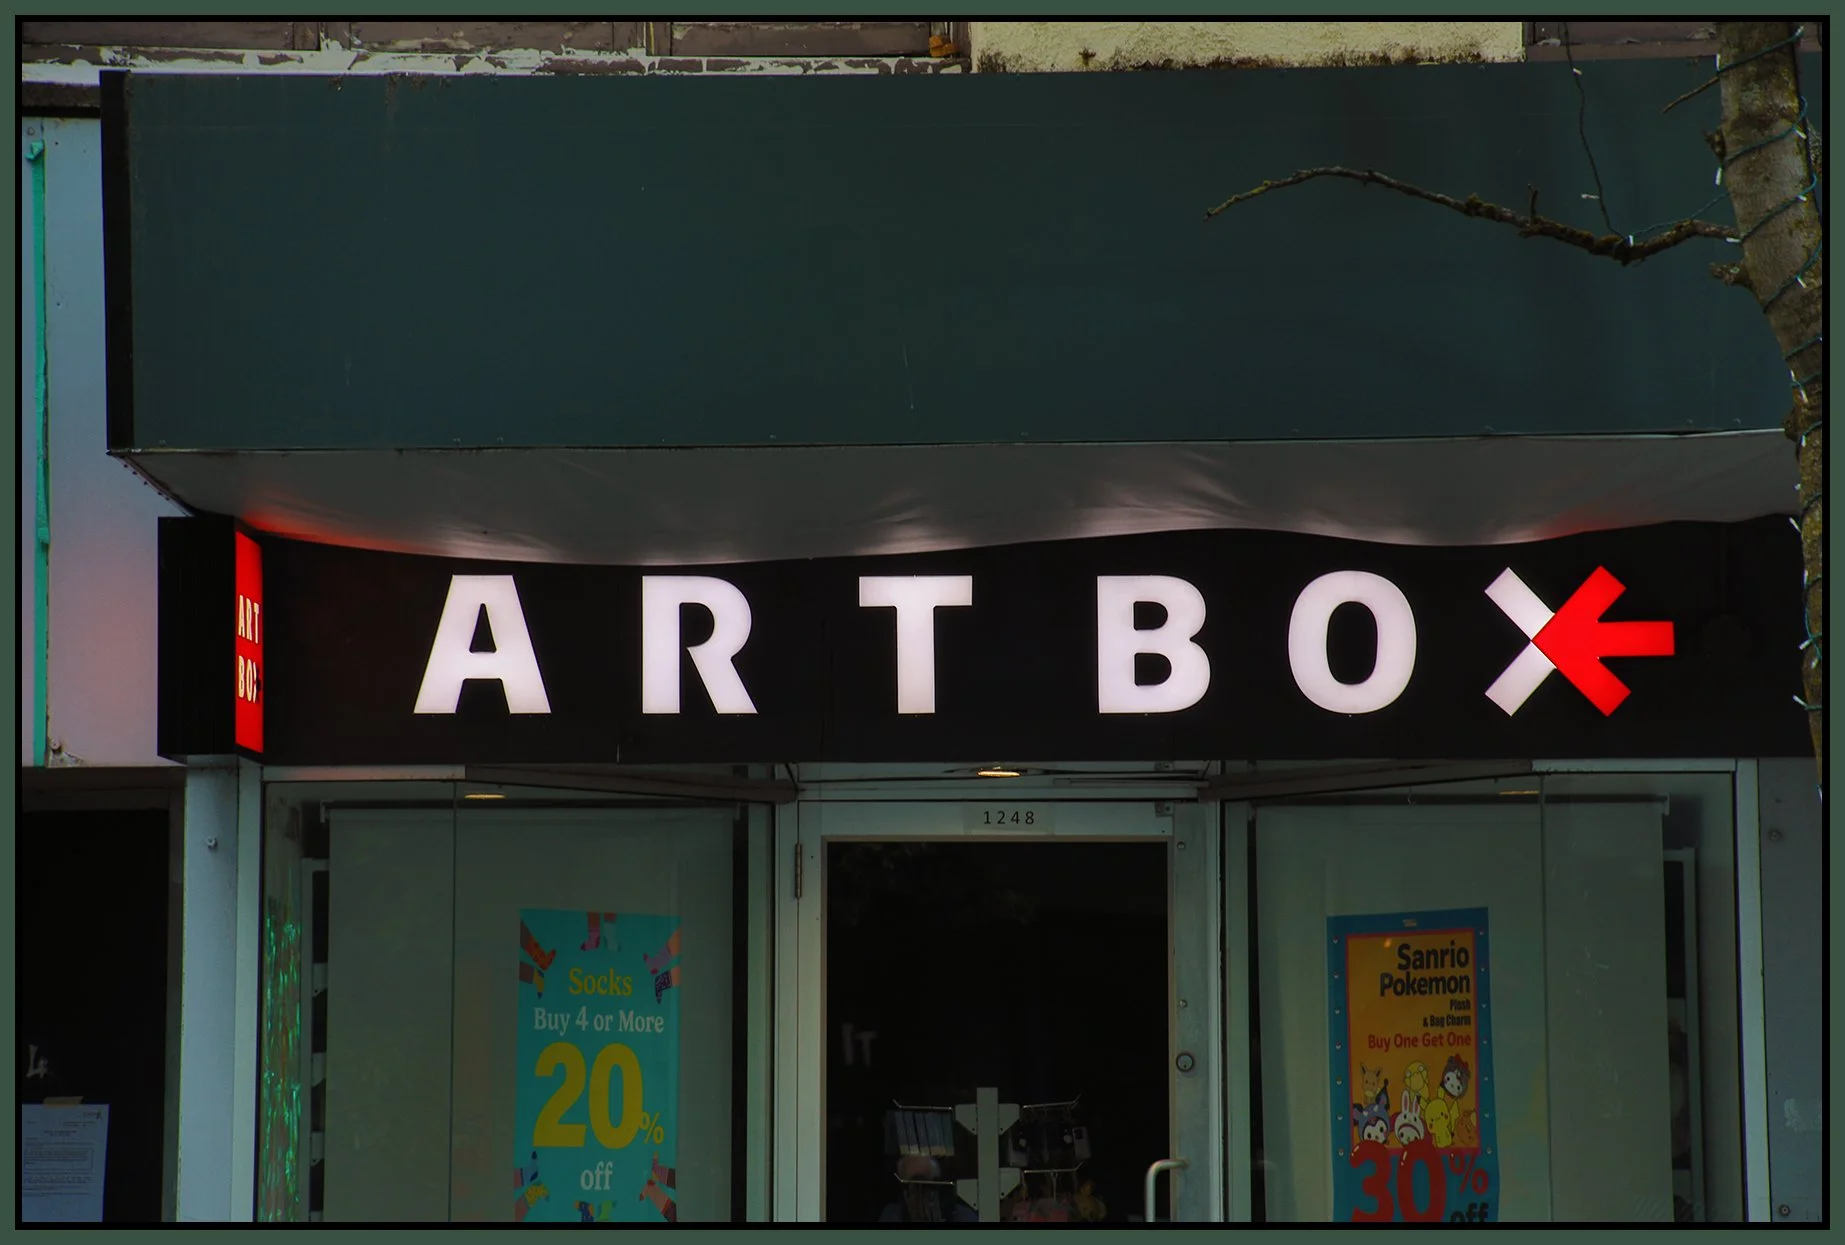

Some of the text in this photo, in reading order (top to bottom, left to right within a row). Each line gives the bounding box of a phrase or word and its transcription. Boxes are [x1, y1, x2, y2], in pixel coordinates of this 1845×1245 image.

[237, 594, 260, 644] ART
[983, 811, 1035, 825] 1248
[1397, 940, 1469, 970] Sanrio
[568, 967, 633, 997] Socks
[1380, 972, 1470, 997] Pokemon
[1450, 999, 1471, 1010] Plush
[533, 1006, 665, 1037] Buy 4 or More
[1423, 1014, 1471, 1027] & Bag Charm
[1368, 1032, 1471, 1052] Buy One Get One
[533, 1041, 664, 1149] 20%
[580, 1162, 614, 1190] off
[1350, 1140, 1489, 1222] 30%
